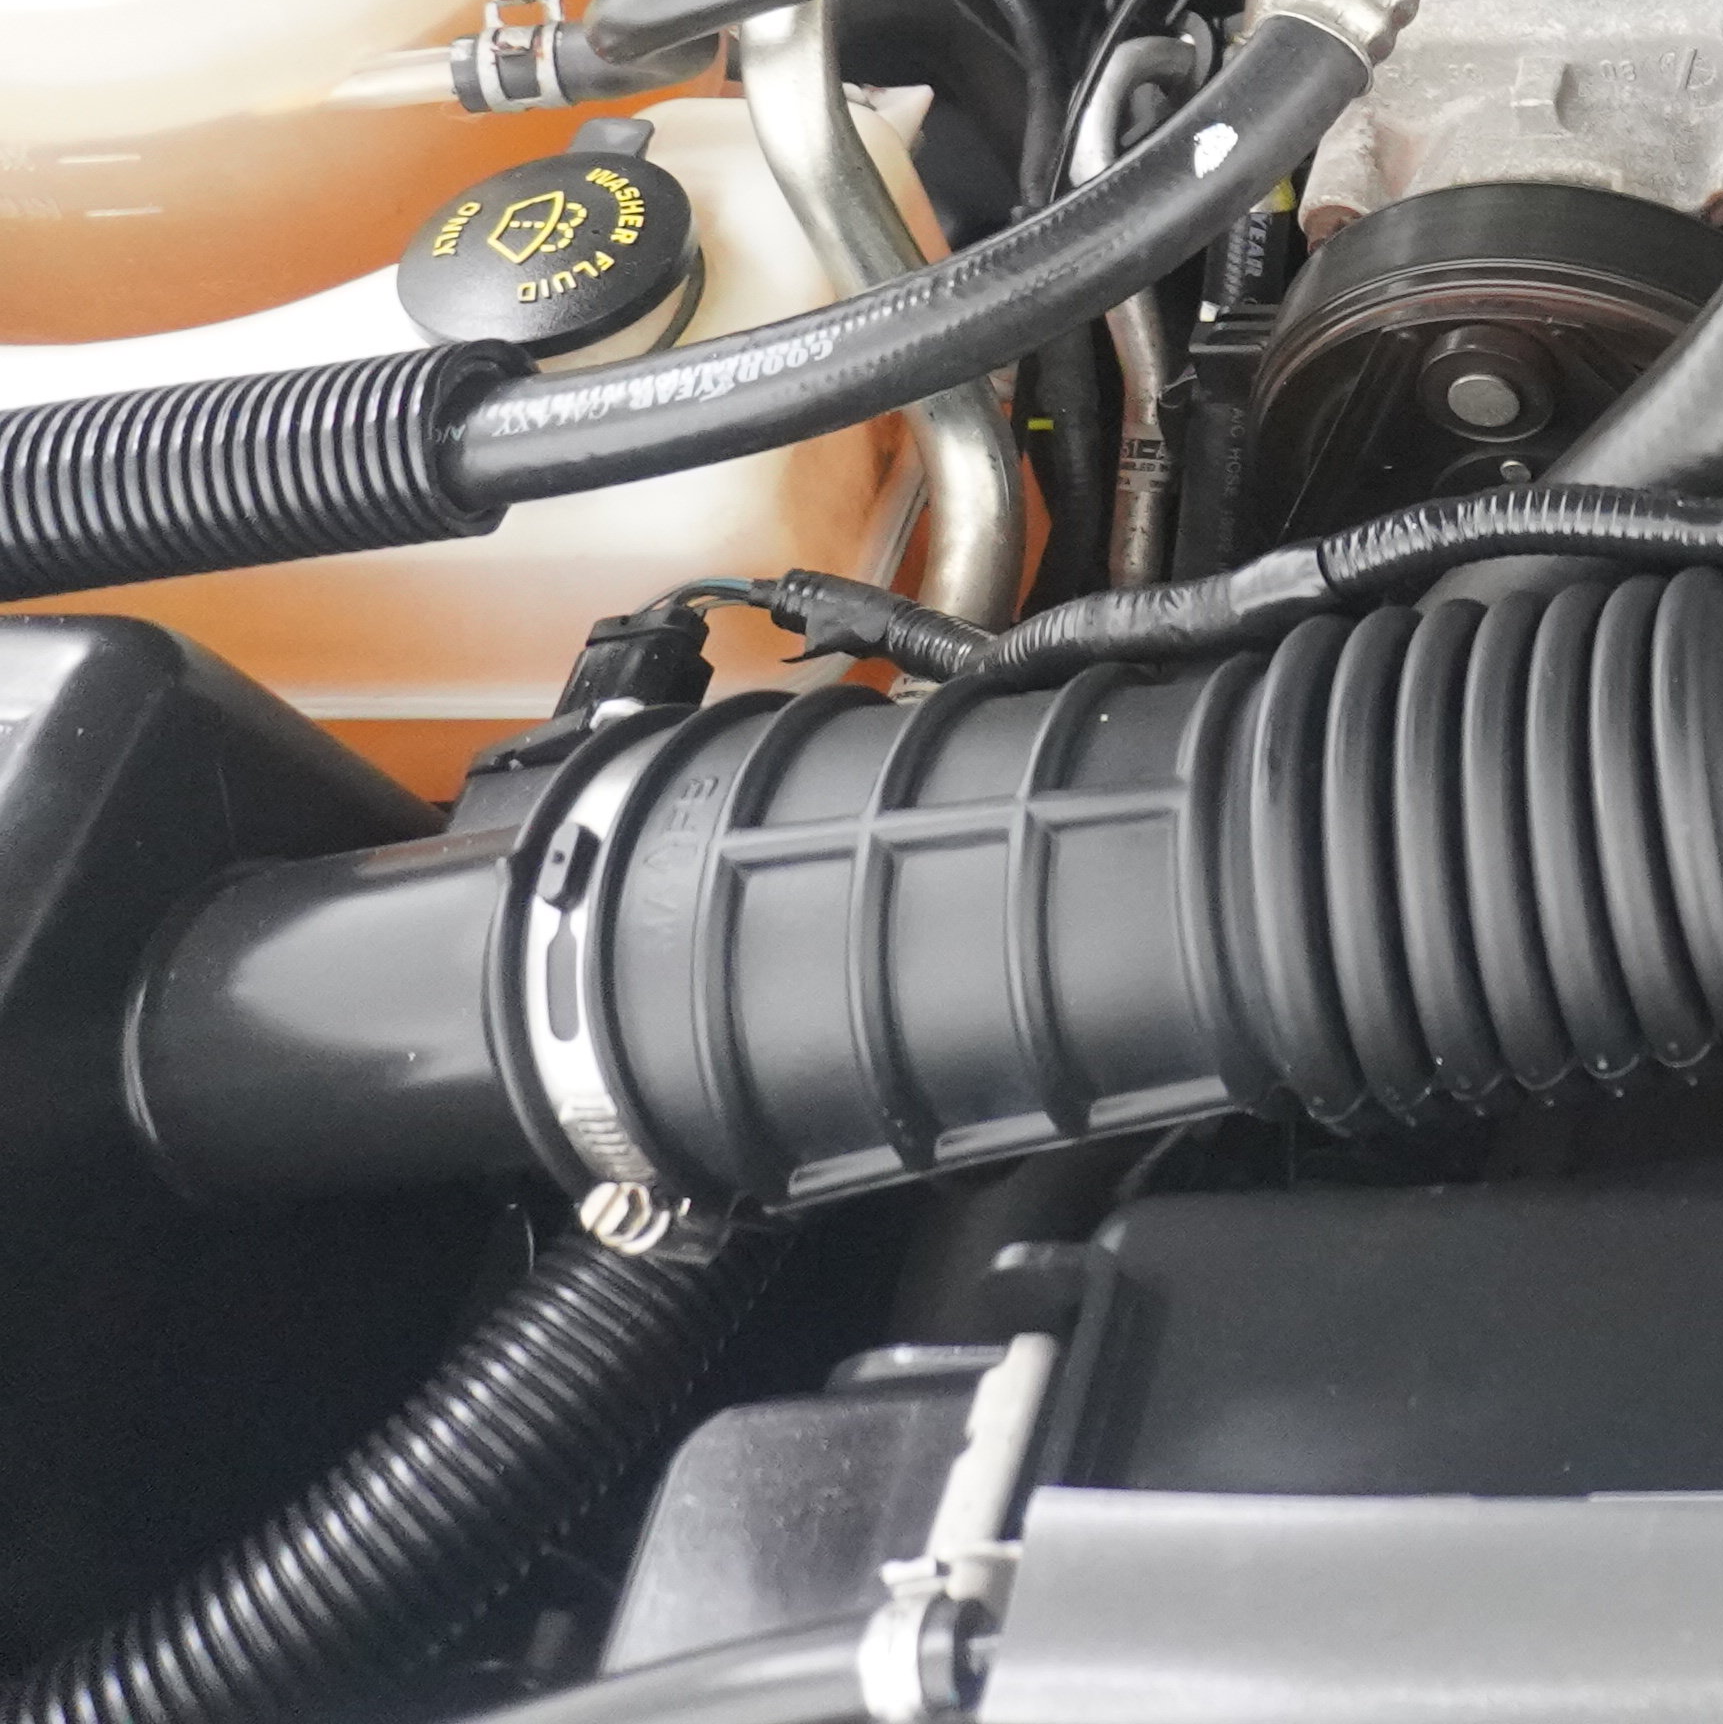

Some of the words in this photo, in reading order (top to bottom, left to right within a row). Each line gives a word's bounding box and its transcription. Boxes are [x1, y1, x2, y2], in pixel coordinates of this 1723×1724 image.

[432, 201, 482, 258] ONLY
[585, 167, 645, 247] WASHER
[516, 250, 616, 304] FLUID
